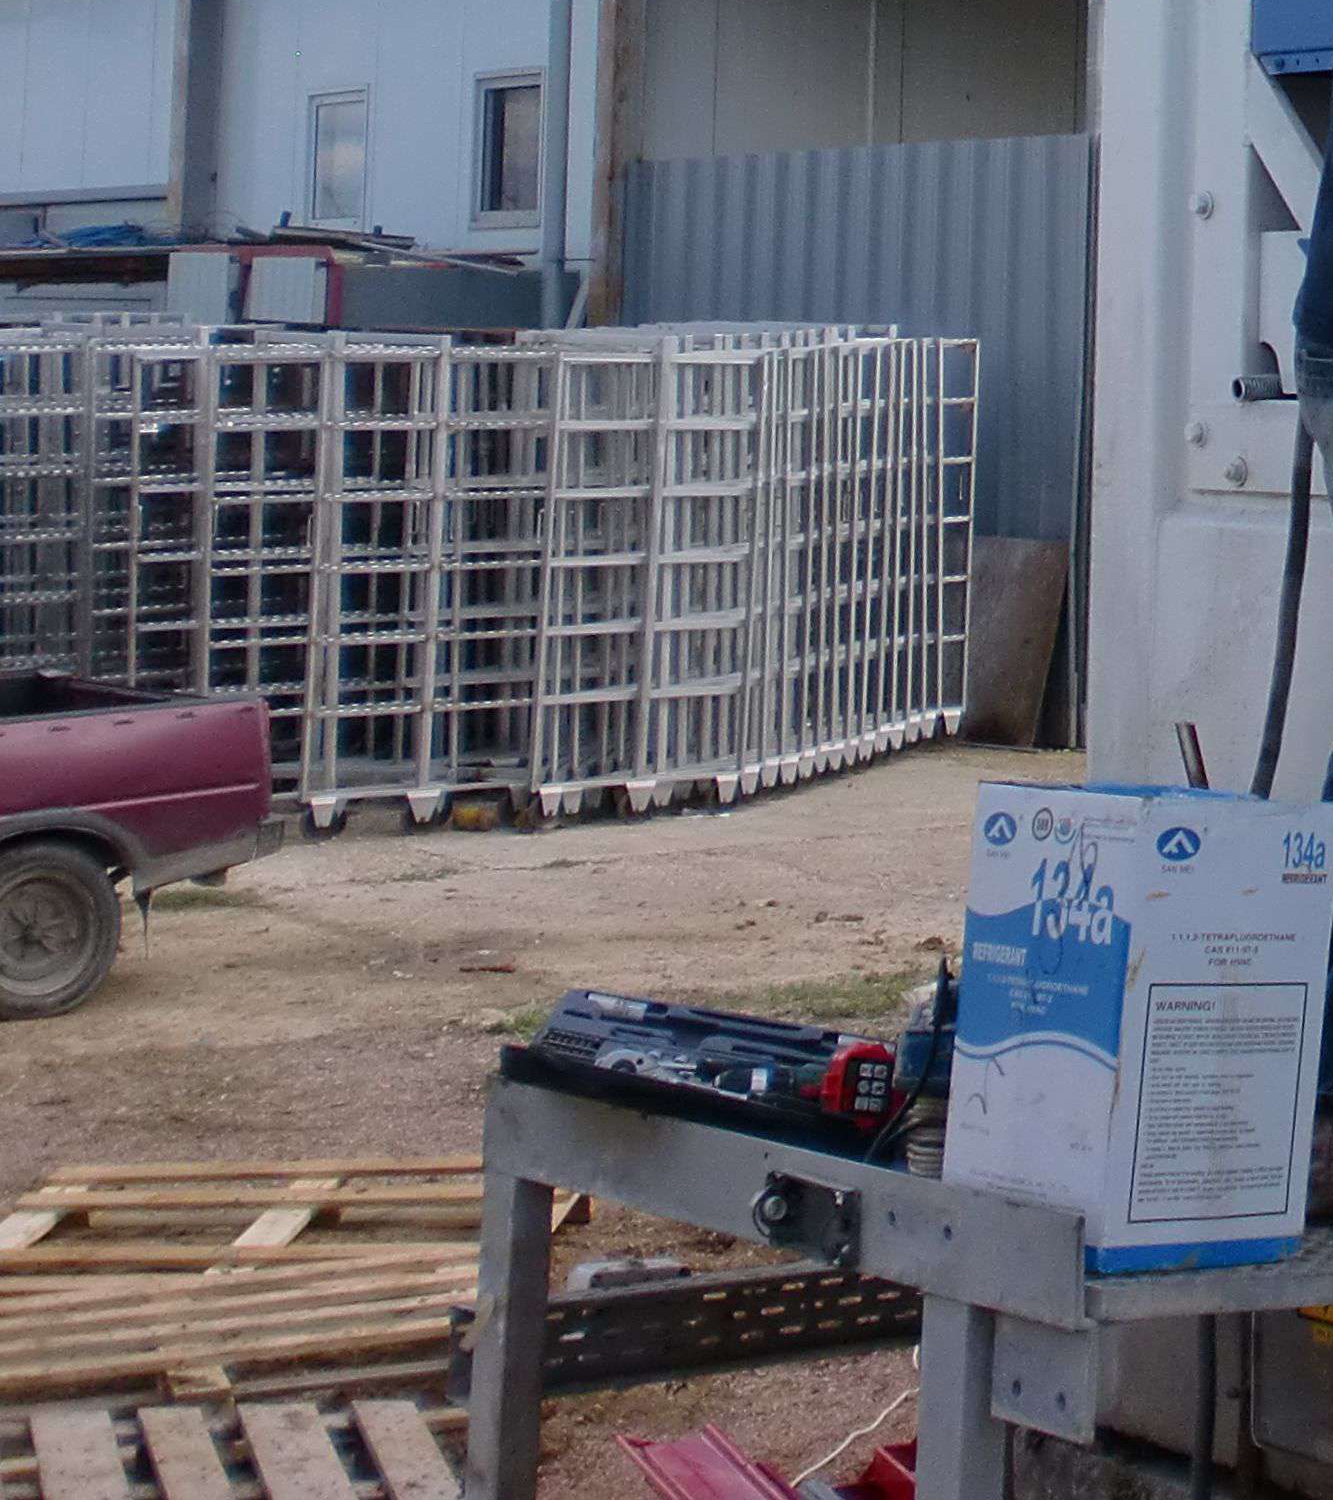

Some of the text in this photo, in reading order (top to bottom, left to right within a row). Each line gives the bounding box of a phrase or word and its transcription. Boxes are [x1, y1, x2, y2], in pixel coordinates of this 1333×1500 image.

[1282, 831, 1326, 870] 134a
[1031, 857, 1114, 946] 134a
[1155, 1001, 1217, 1012] WARNING!
